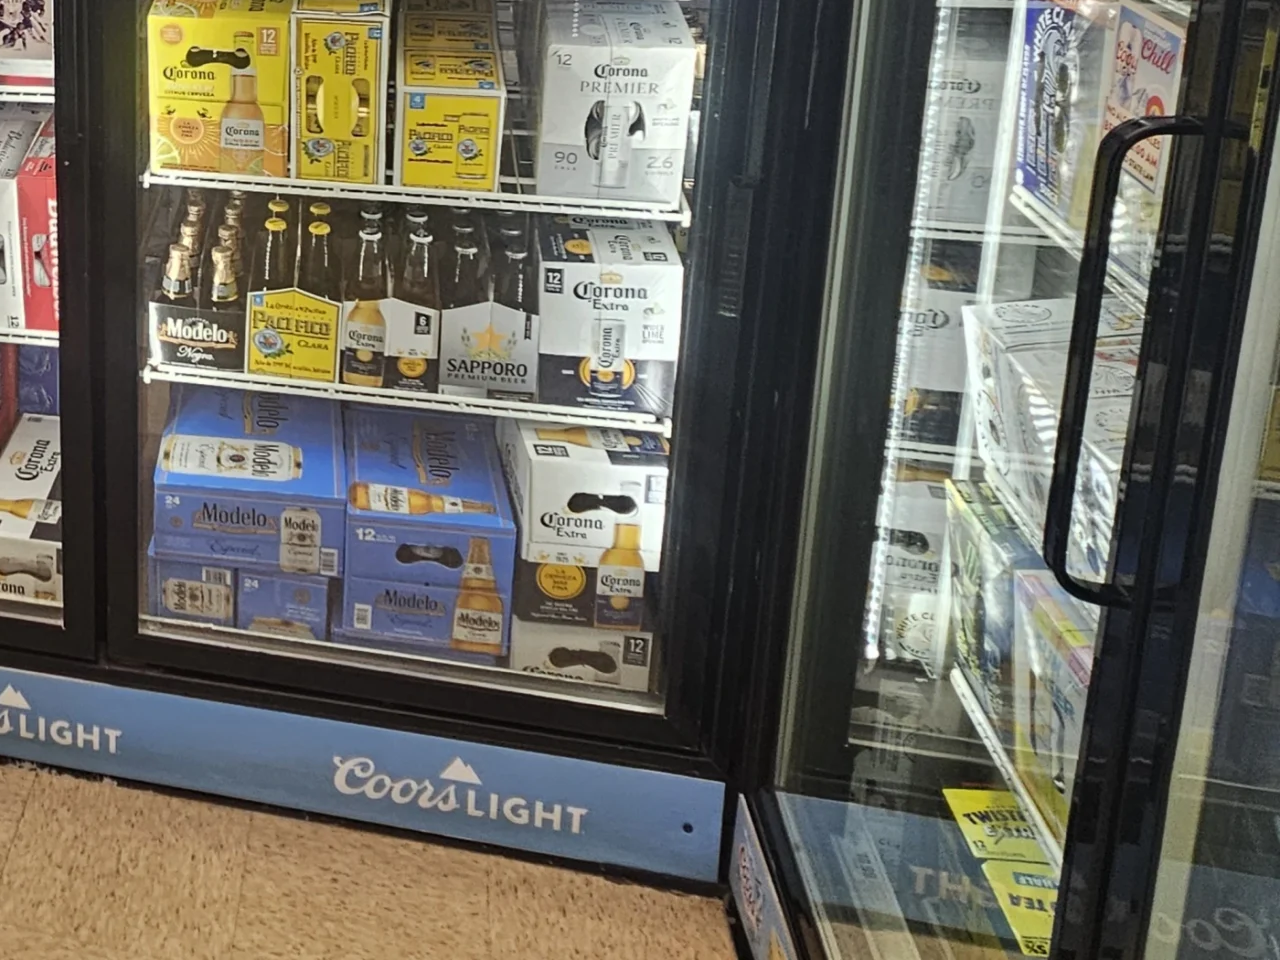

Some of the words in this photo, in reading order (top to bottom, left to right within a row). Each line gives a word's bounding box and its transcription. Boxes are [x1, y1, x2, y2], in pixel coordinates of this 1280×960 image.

[1139, 36, 1177, 75] Chill
[163, 65, 216, 81] Corona
[593, 63, 649, 80] Corona
[580, 79, 660, 95] PREMIER
[225, 126, 260, 137] Corona
[553, 151, 578, 165] 90
[547, 271, 562, 285] 12
[573, 280, 648, 301] Corona
[588, 298, 629, 312] Extra
[166, 317, 228, 343] Modelo
[348, 329, 385, 343] Corona
[176, 344, 214, 364] Negra
[446, 358, 528, 378] SAPPORO
[446, 372, 498, 383] PREMIUM
[500, 376, 527, 385] BEER
[164, 495, 181, 506] 24
[201, 502, 267, 528] Modelo
[540, 511, 604, 531] Corona
[284, 516, 319, 532] Modelo
[355, 527, 375, 541] 12
[556, 527, 587, 539] Extra
[243, 578, 259, 589] 24
[600, 574, 641, 587] Corona
[384, 589, 438, 611] Modelo
[628, 639, 644, 653] 12
[20, 713, 122, 755] LIGHT
[333, 754, 460, 812] Coors
[467, 788, 588, 835] LIGHT
